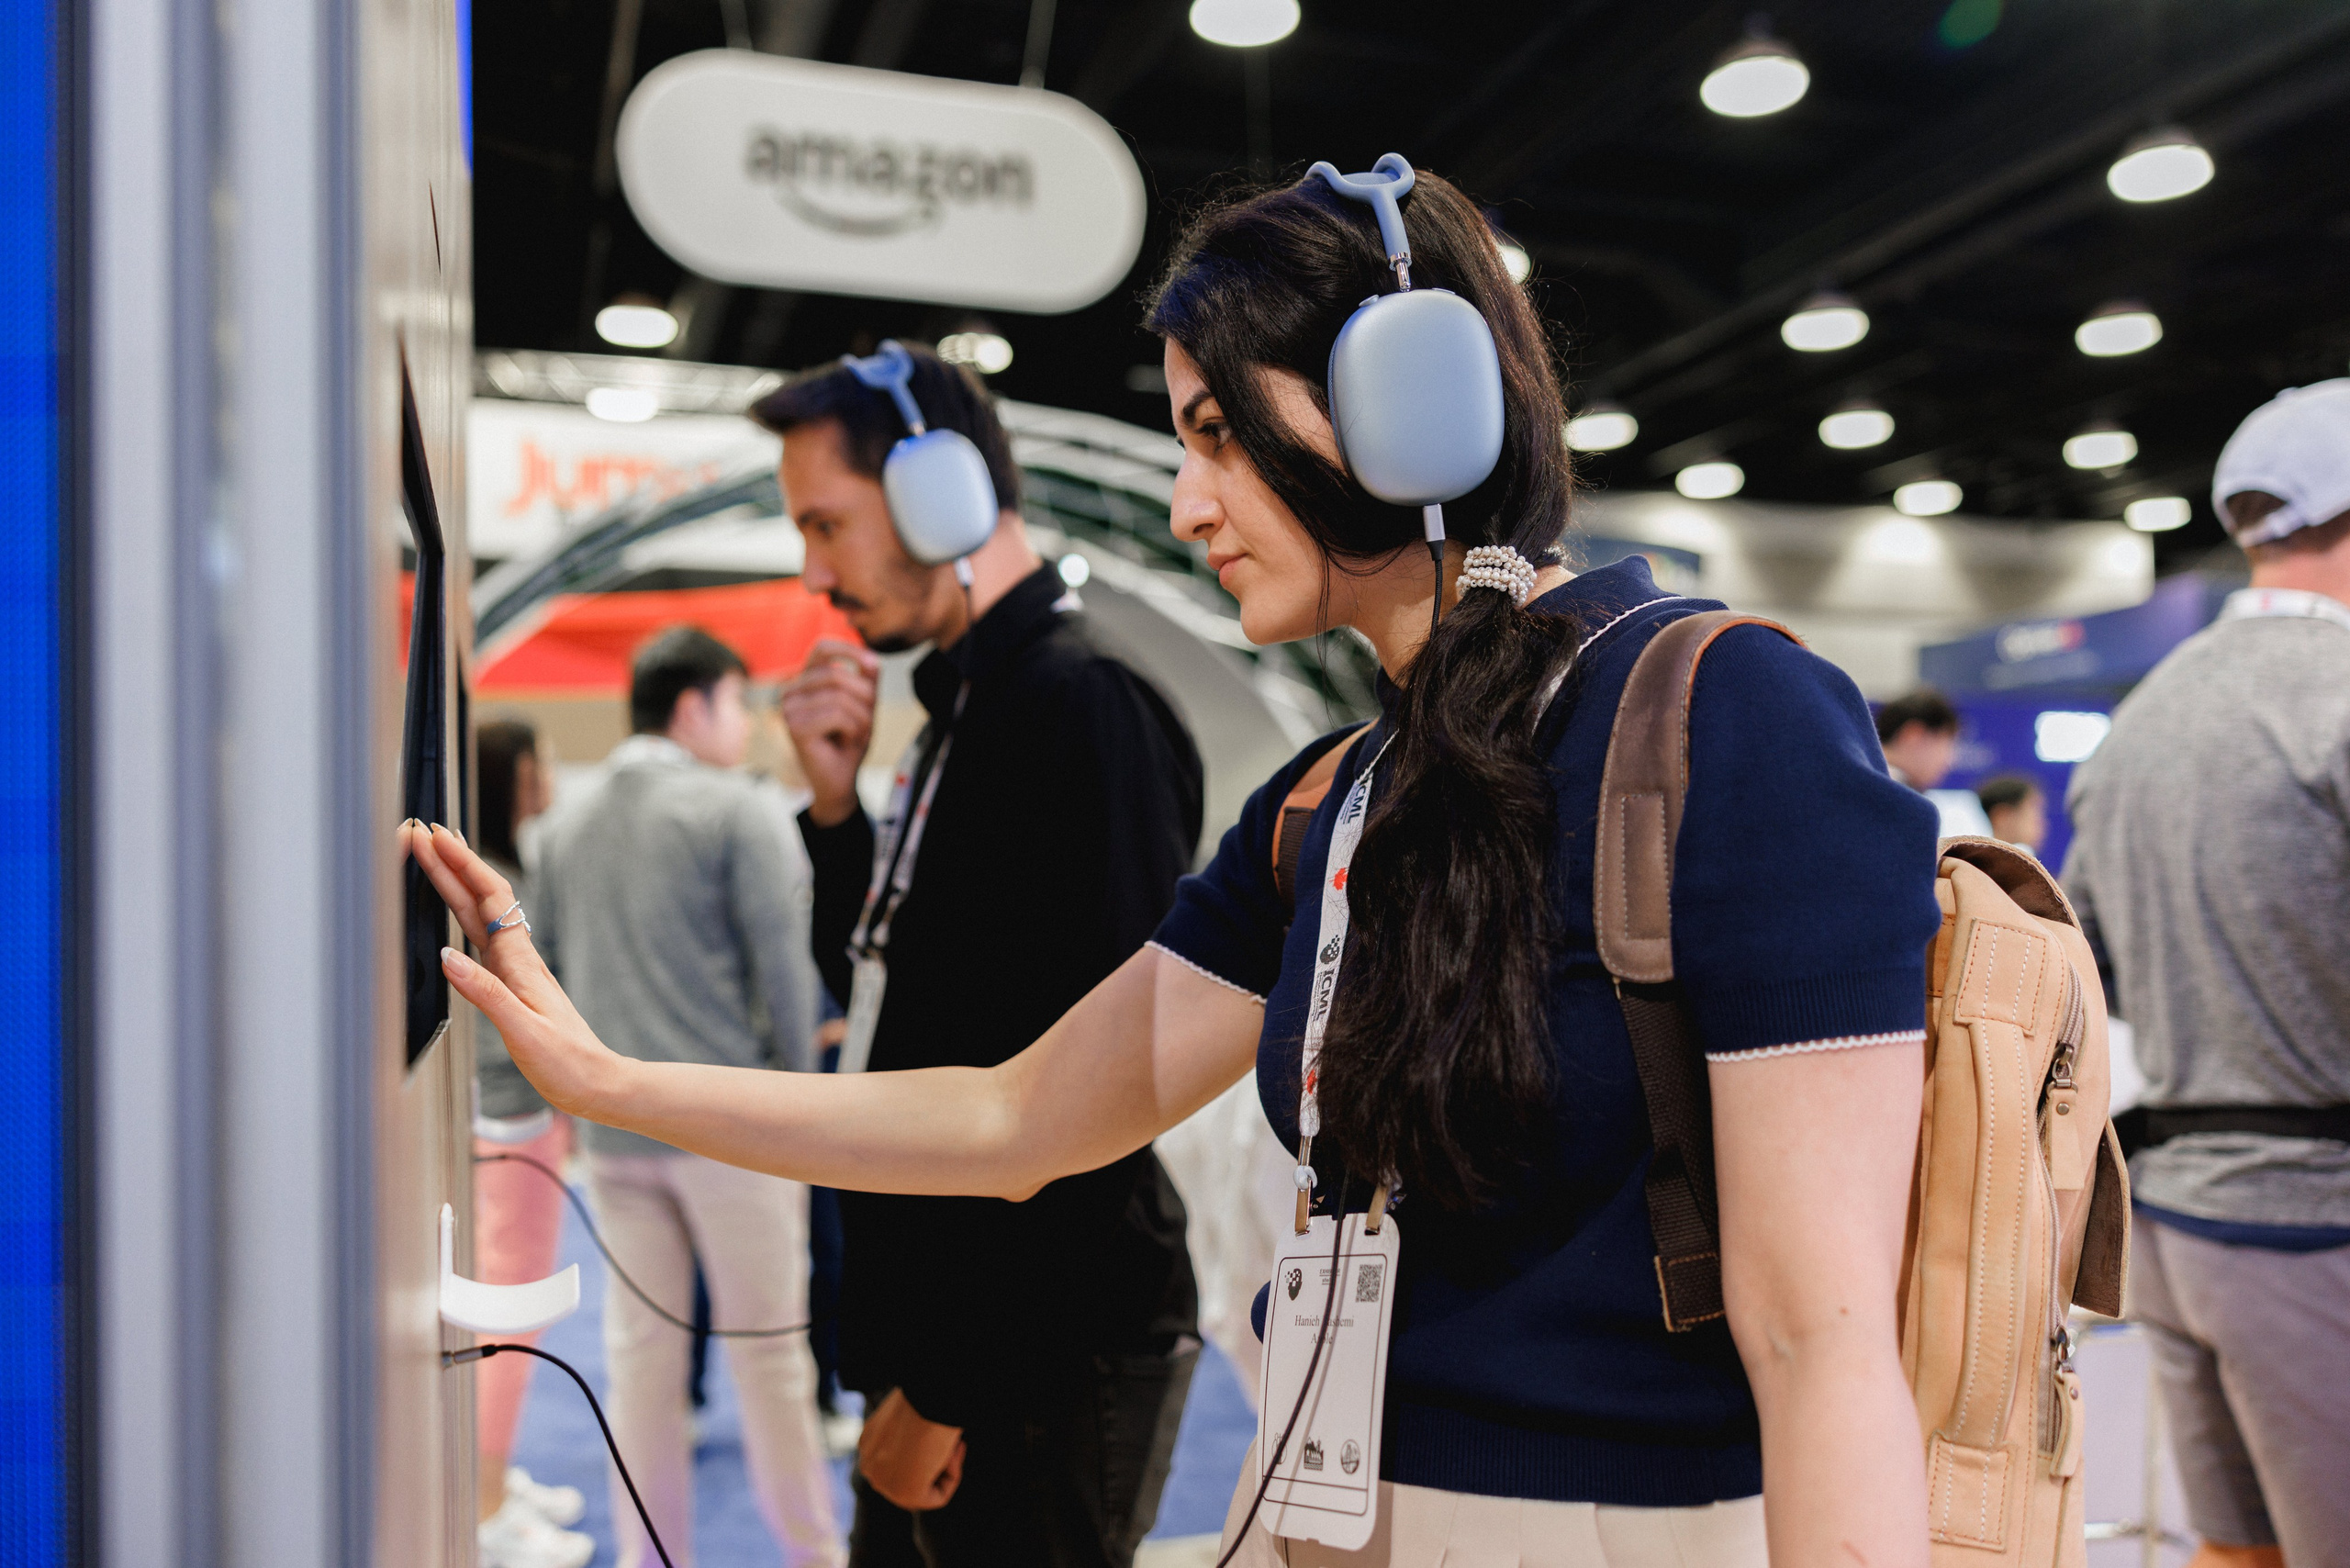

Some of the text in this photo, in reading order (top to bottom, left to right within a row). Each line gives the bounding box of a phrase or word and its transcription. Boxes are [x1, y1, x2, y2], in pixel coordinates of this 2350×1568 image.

[744, 125, 1035, 212] amazon
[1318, 968, 1336, 1015] ICML
[1324, 1315, 1354, 1327] ashemi
